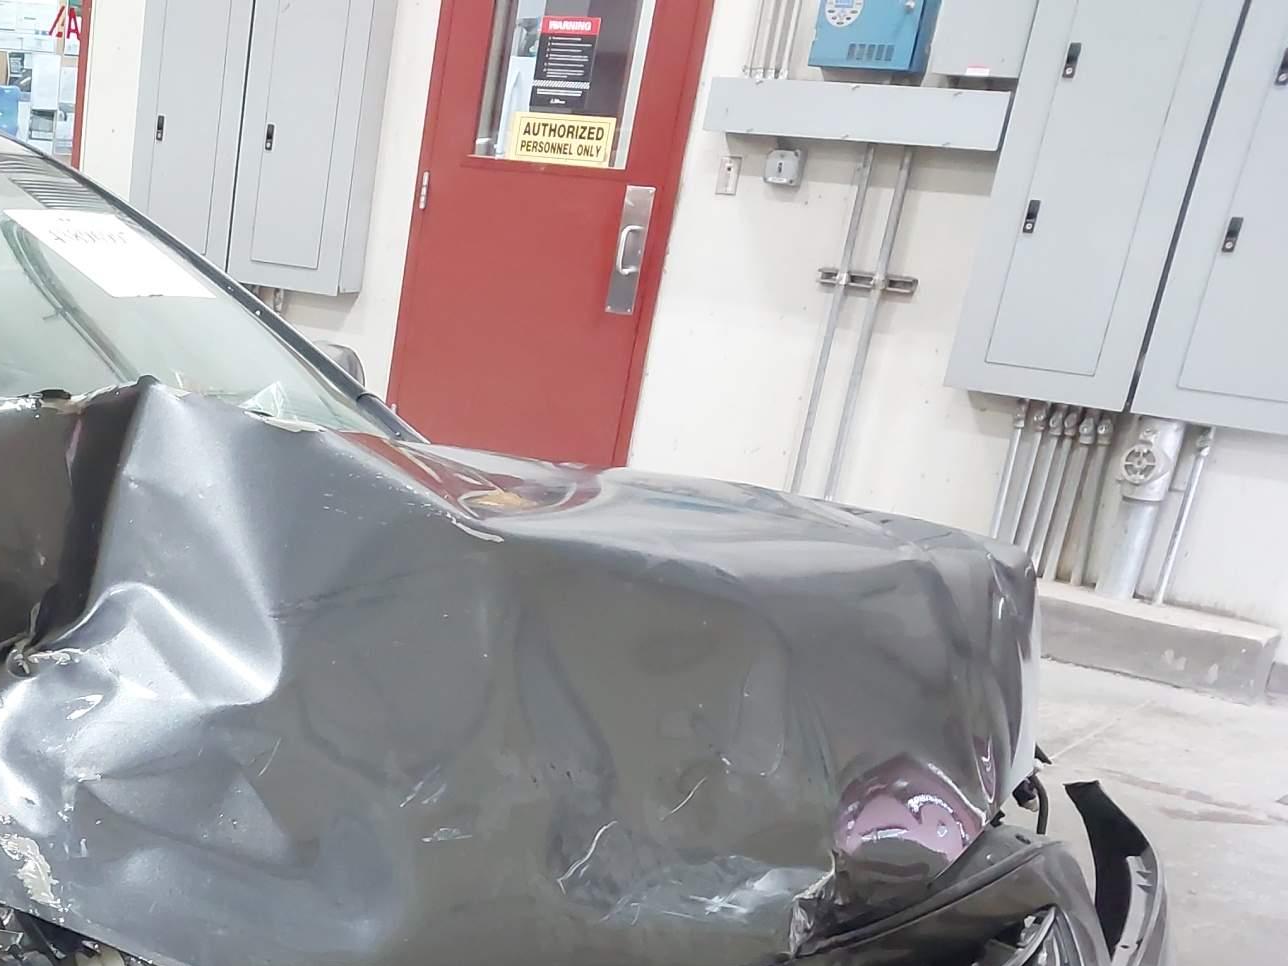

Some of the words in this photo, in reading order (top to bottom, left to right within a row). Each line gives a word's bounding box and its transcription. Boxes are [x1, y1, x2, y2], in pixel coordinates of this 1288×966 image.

[548, 20, 592, 31] WARNING
[522, 121, 605, 141] AUTHORIZED
[519, 140, 573, 156] PERSONNEL
[576, 143, 602, 158] ONLY
